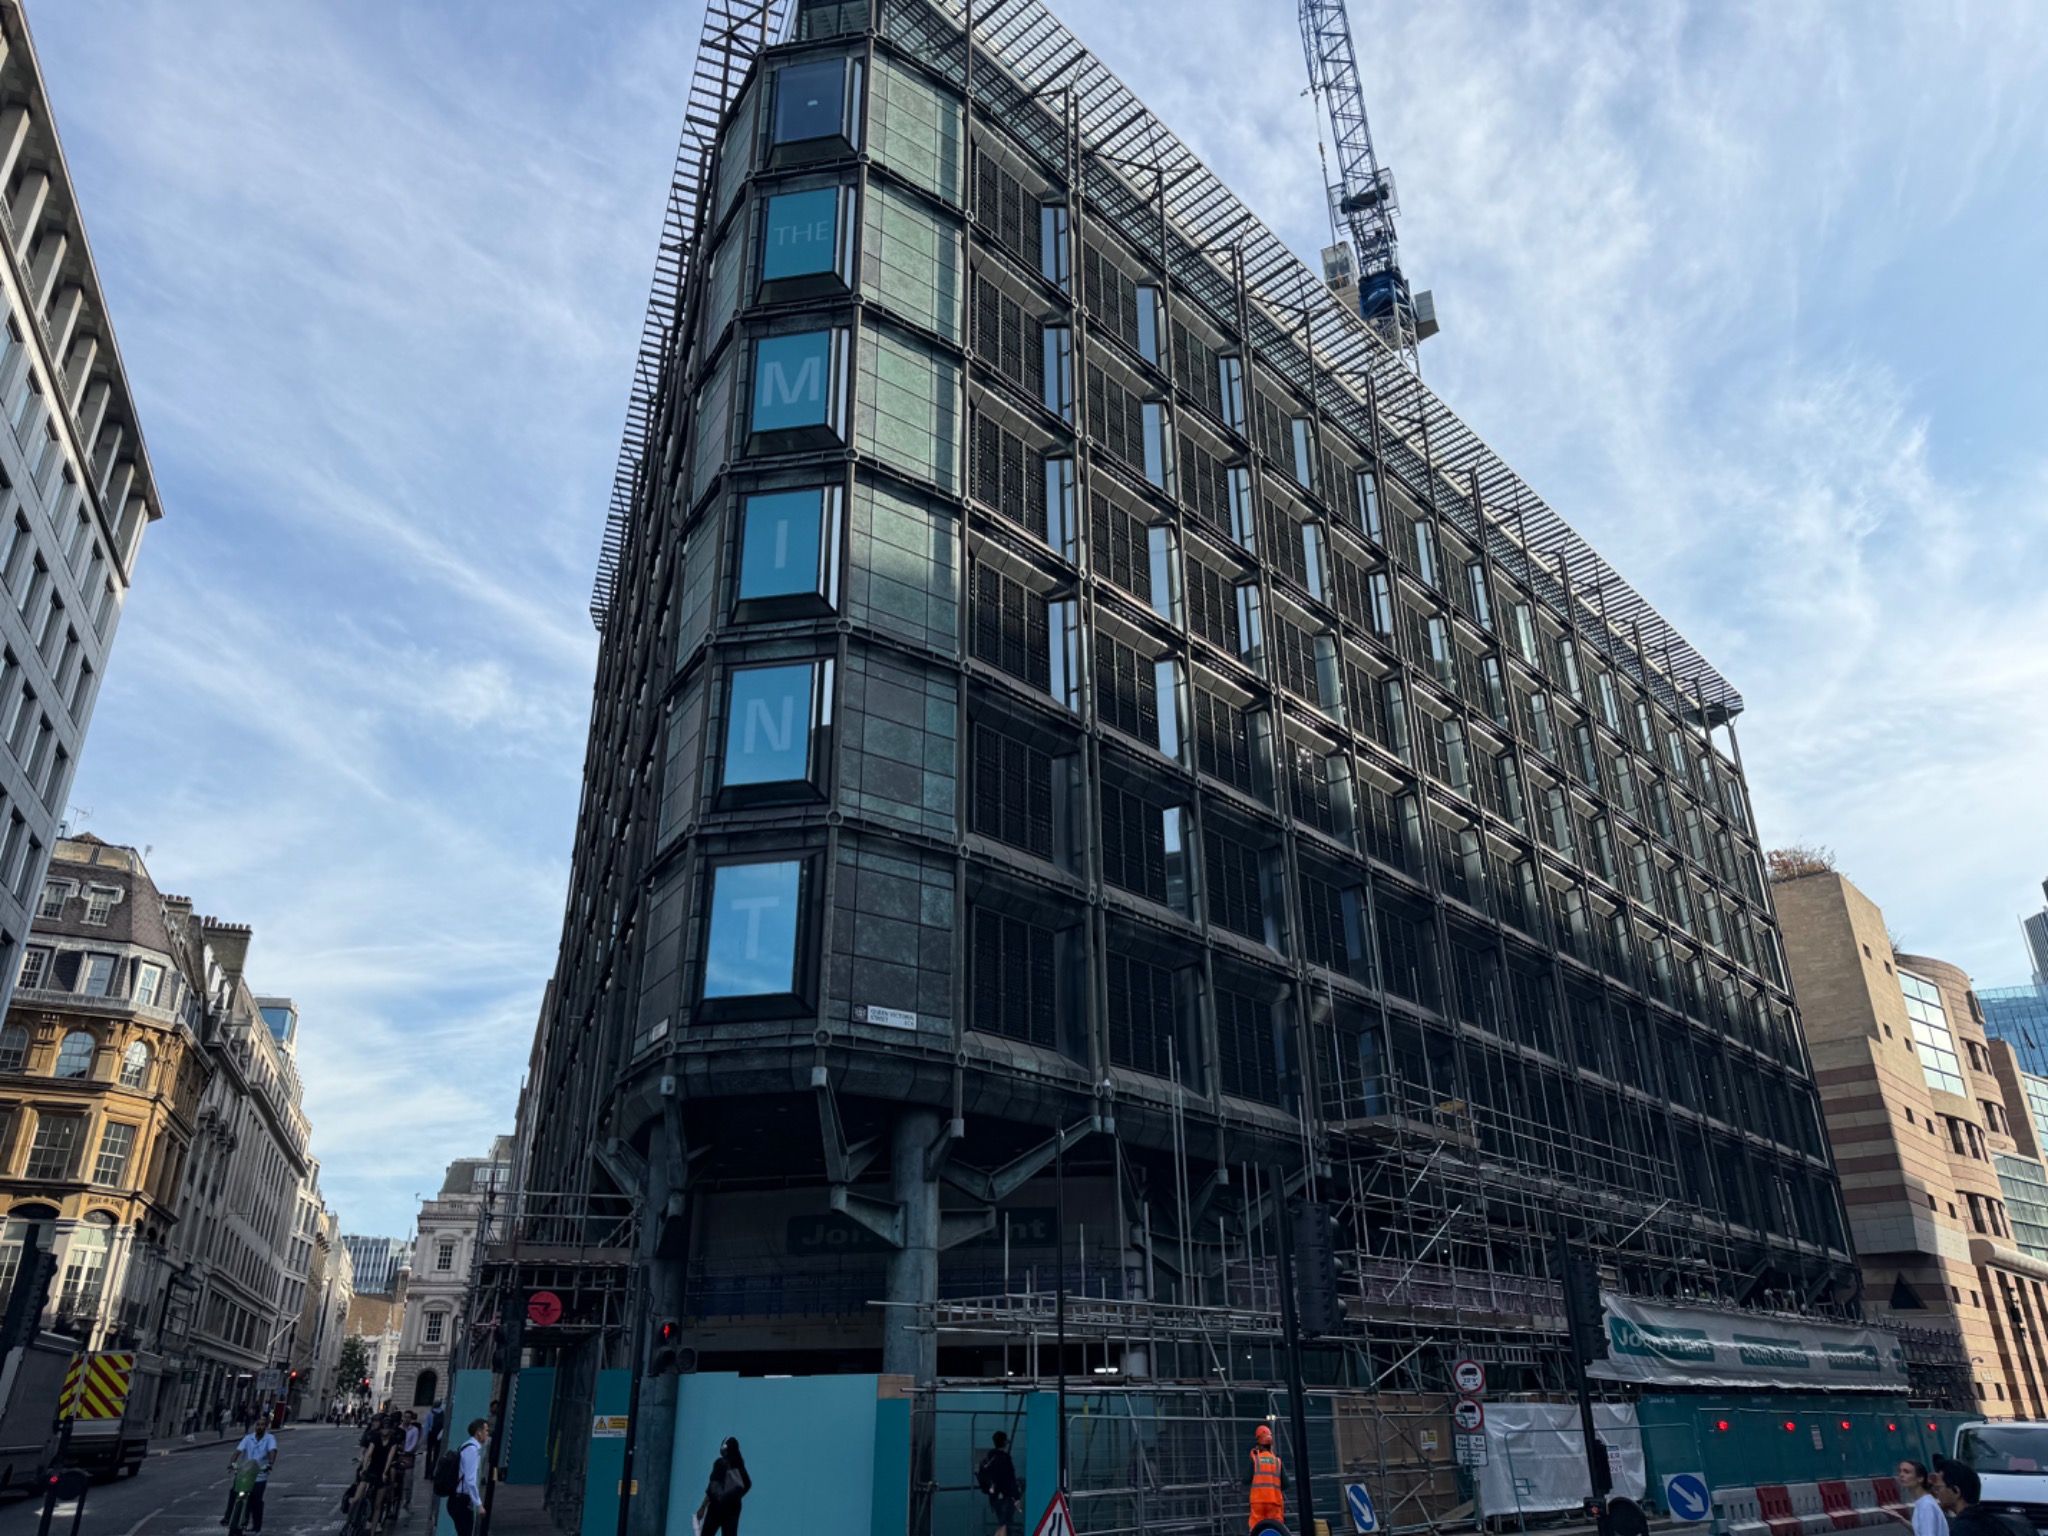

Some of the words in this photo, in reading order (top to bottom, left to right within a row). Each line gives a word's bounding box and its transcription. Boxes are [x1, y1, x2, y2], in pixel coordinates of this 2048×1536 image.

[774, 220, 830, 246] THE
[762, 355, 823, 407] M
[774, 519, 788, 569] I
[743, 696, 794, 754] N
[731, 896, 781, 960] T
